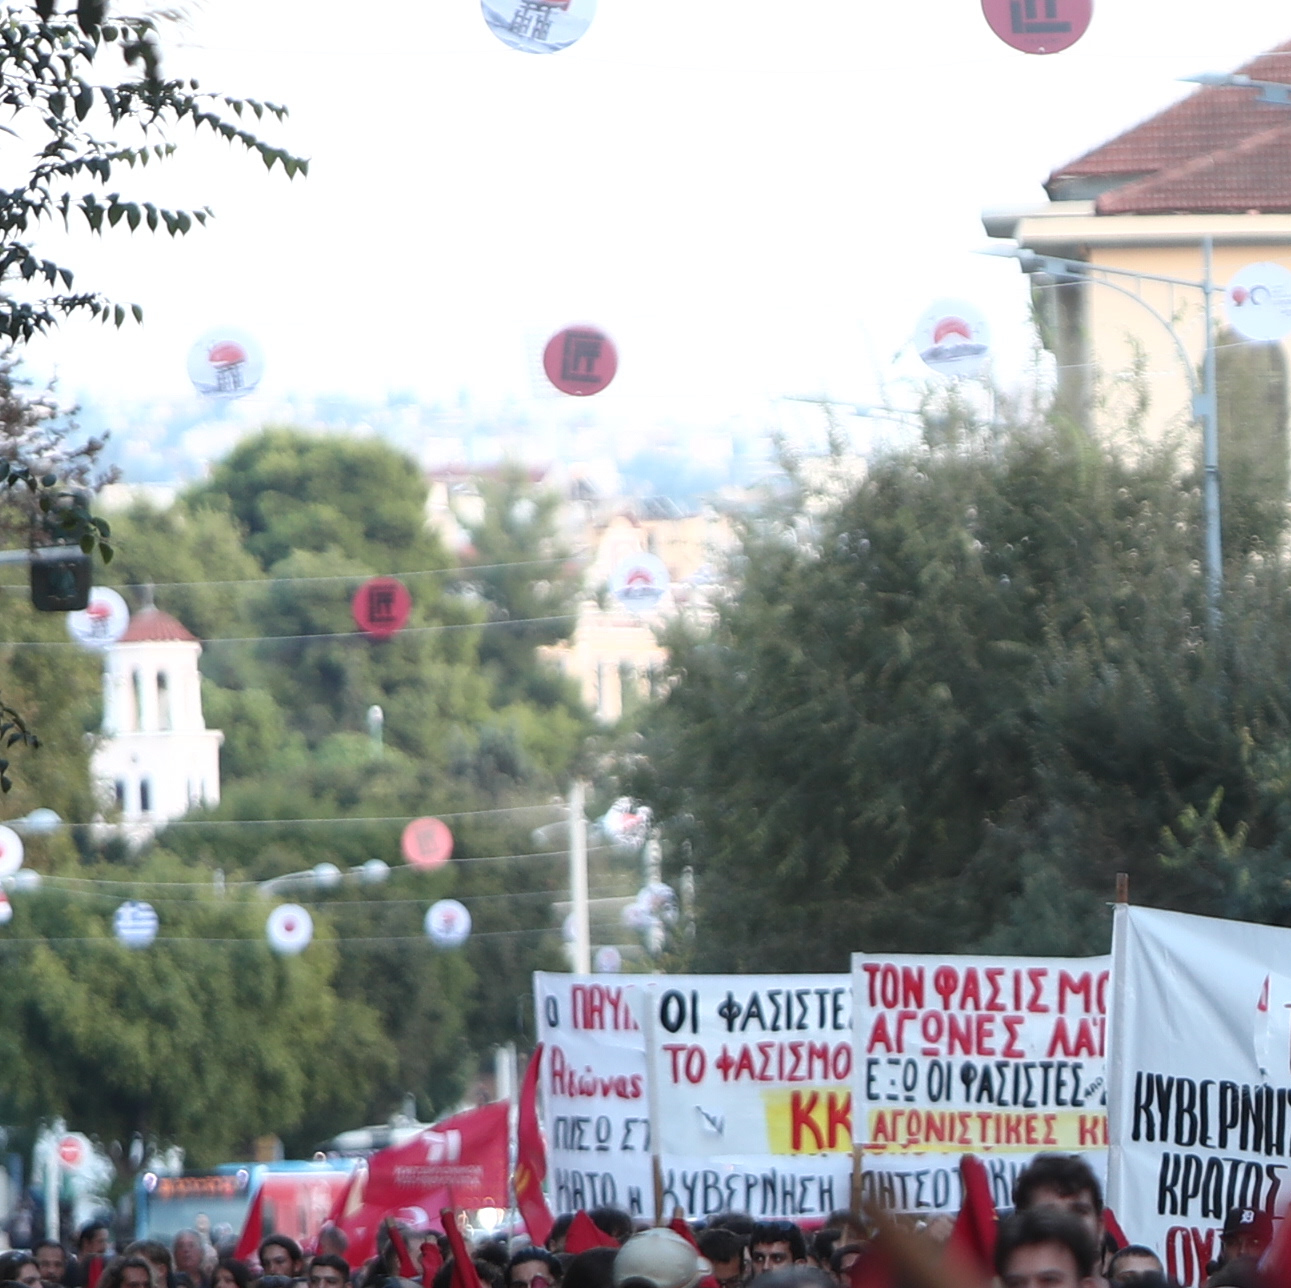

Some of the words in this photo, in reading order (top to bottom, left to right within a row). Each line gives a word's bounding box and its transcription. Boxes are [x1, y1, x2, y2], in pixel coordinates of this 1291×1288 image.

[659, 988, 699, 1034] ΟΙ
[717, 986, 852, 1033] ΦΑΣΙΣΤΕ
[862, 962, 925, 1010] ΤΟΝ
[866, 1009, 1026, 1059] ΑΓΩΝΕΣ
[661, 1042, 707, 1084] ΤΟ
[927, 1058, 953, 1103] ΟΙ
[960, 1060, 1085, 1108] ΦΑΣΙΣΤΕΣ
